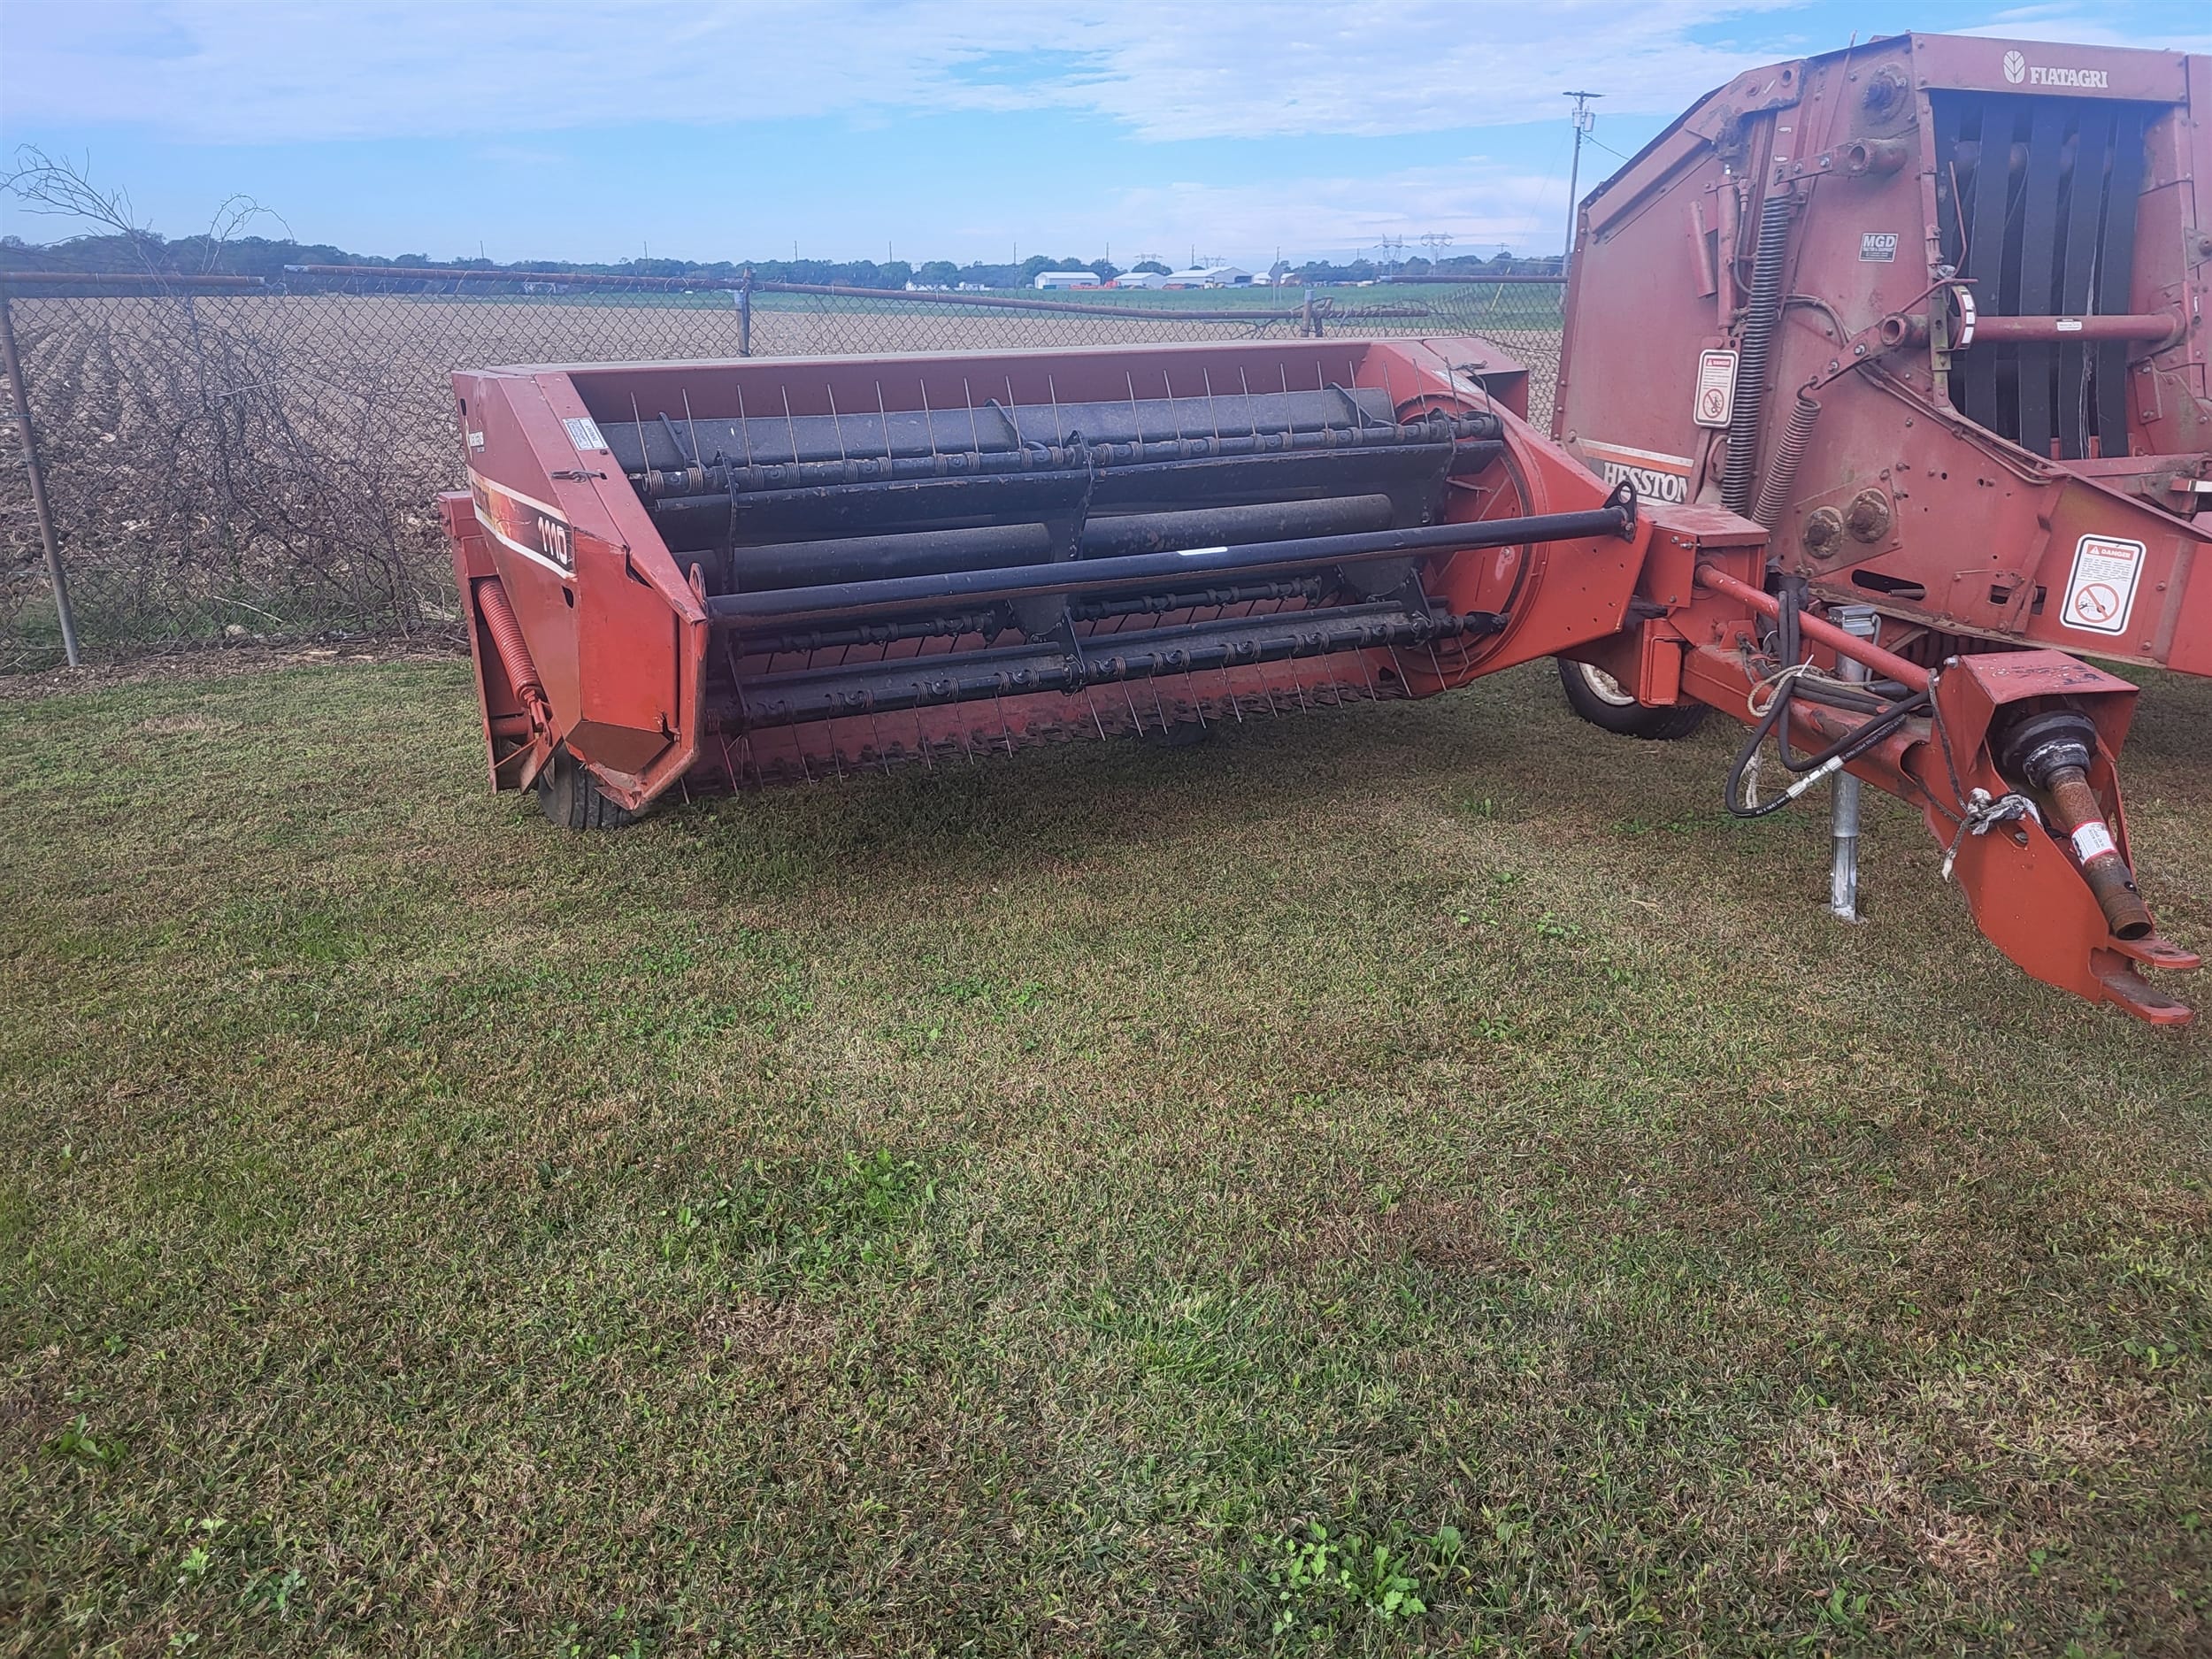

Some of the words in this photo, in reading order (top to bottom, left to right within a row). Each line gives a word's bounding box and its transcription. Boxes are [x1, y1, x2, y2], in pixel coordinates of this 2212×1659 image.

[2030, 66, 2108, 88] FIATAGRI
[1863, 235, 1895, 248] MGD
[537, 516, 568, 565] 1110
[2101, 549, 2131, 559] DANGER
